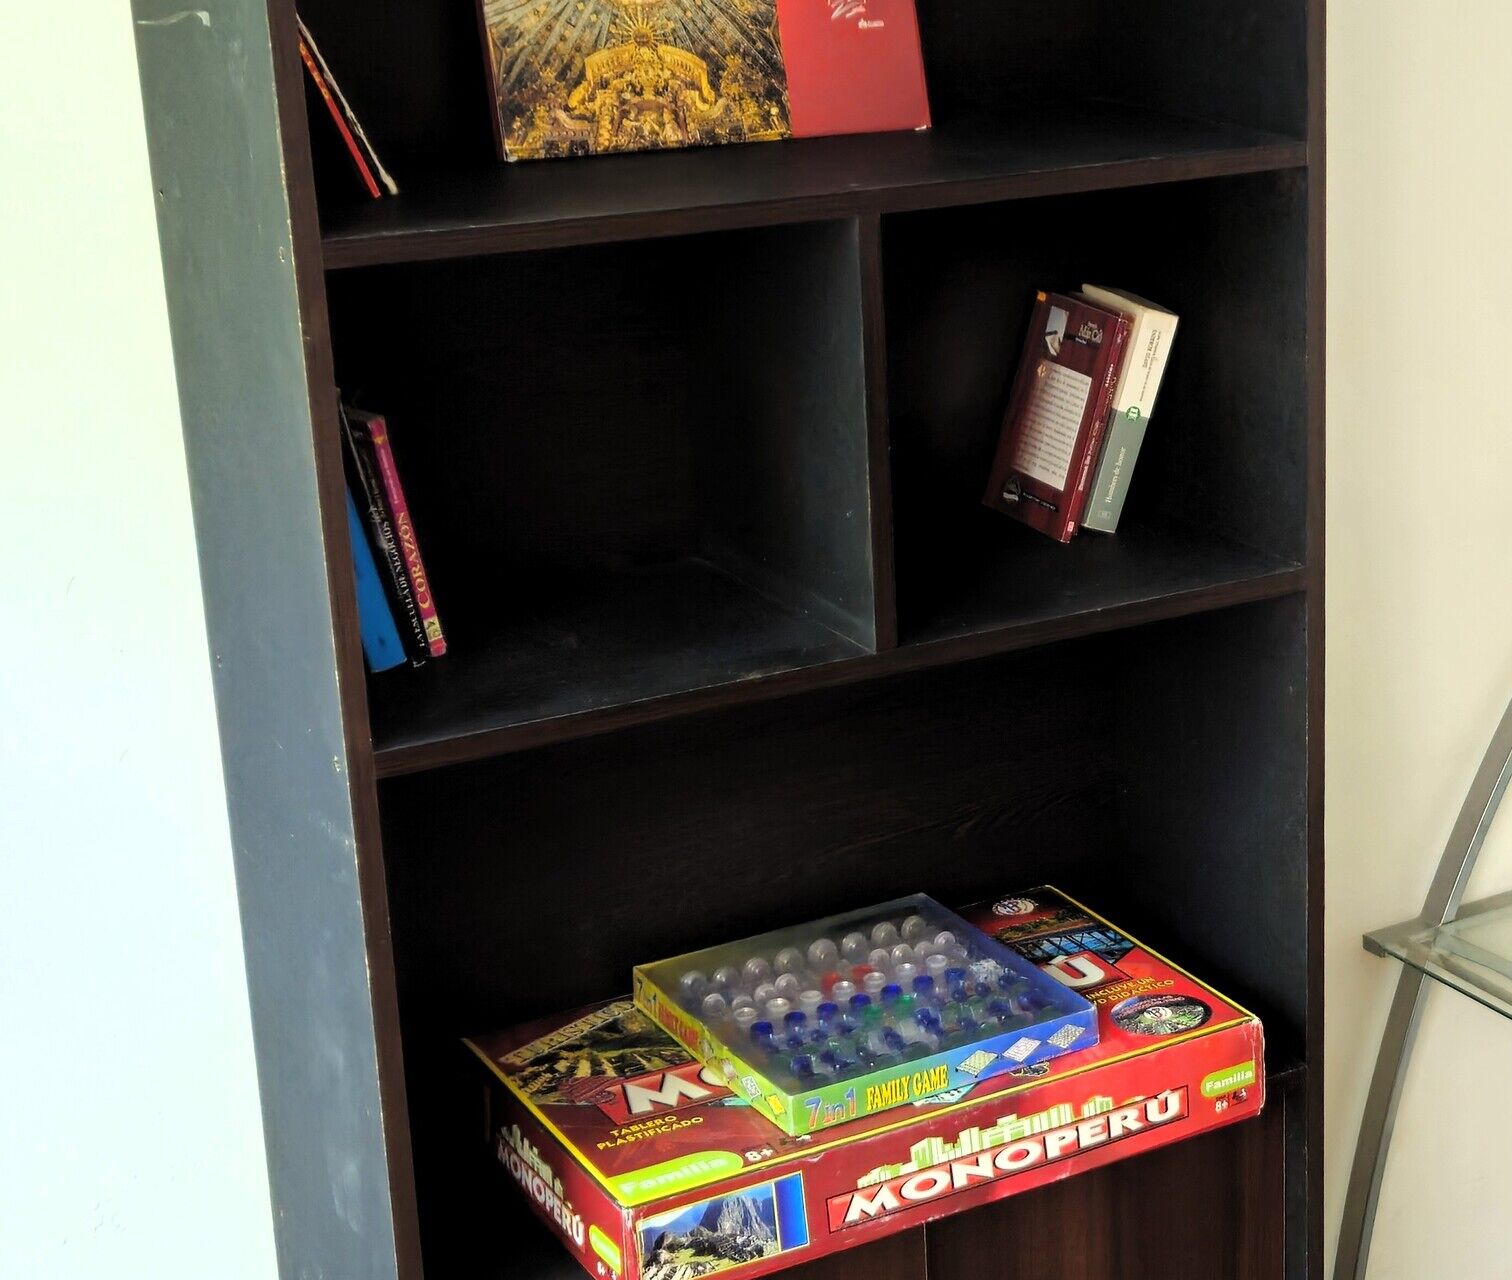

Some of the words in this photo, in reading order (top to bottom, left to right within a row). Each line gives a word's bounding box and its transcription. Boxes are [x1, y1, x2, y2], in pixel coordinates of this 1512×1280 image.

[382, 520, 402, 573] NEGOCIOS
[866, 1073, 911, 1112] FAMILY
[912, 1064, 950, 1097] GAME
[1205, 1070, 1253, 1093] Familia
[596, 1116, 704, 1152] PLASTIFICADO
[610, 1115, 677, 1137] TABLERO
[745, 1148, 774, 1162] 8+
[841, 1089, 1182, 1225] MONOPERÚ
[498, 1139, 585, 1247] MONOPERÚ
[618, 1157, 729, 1195] Familia
